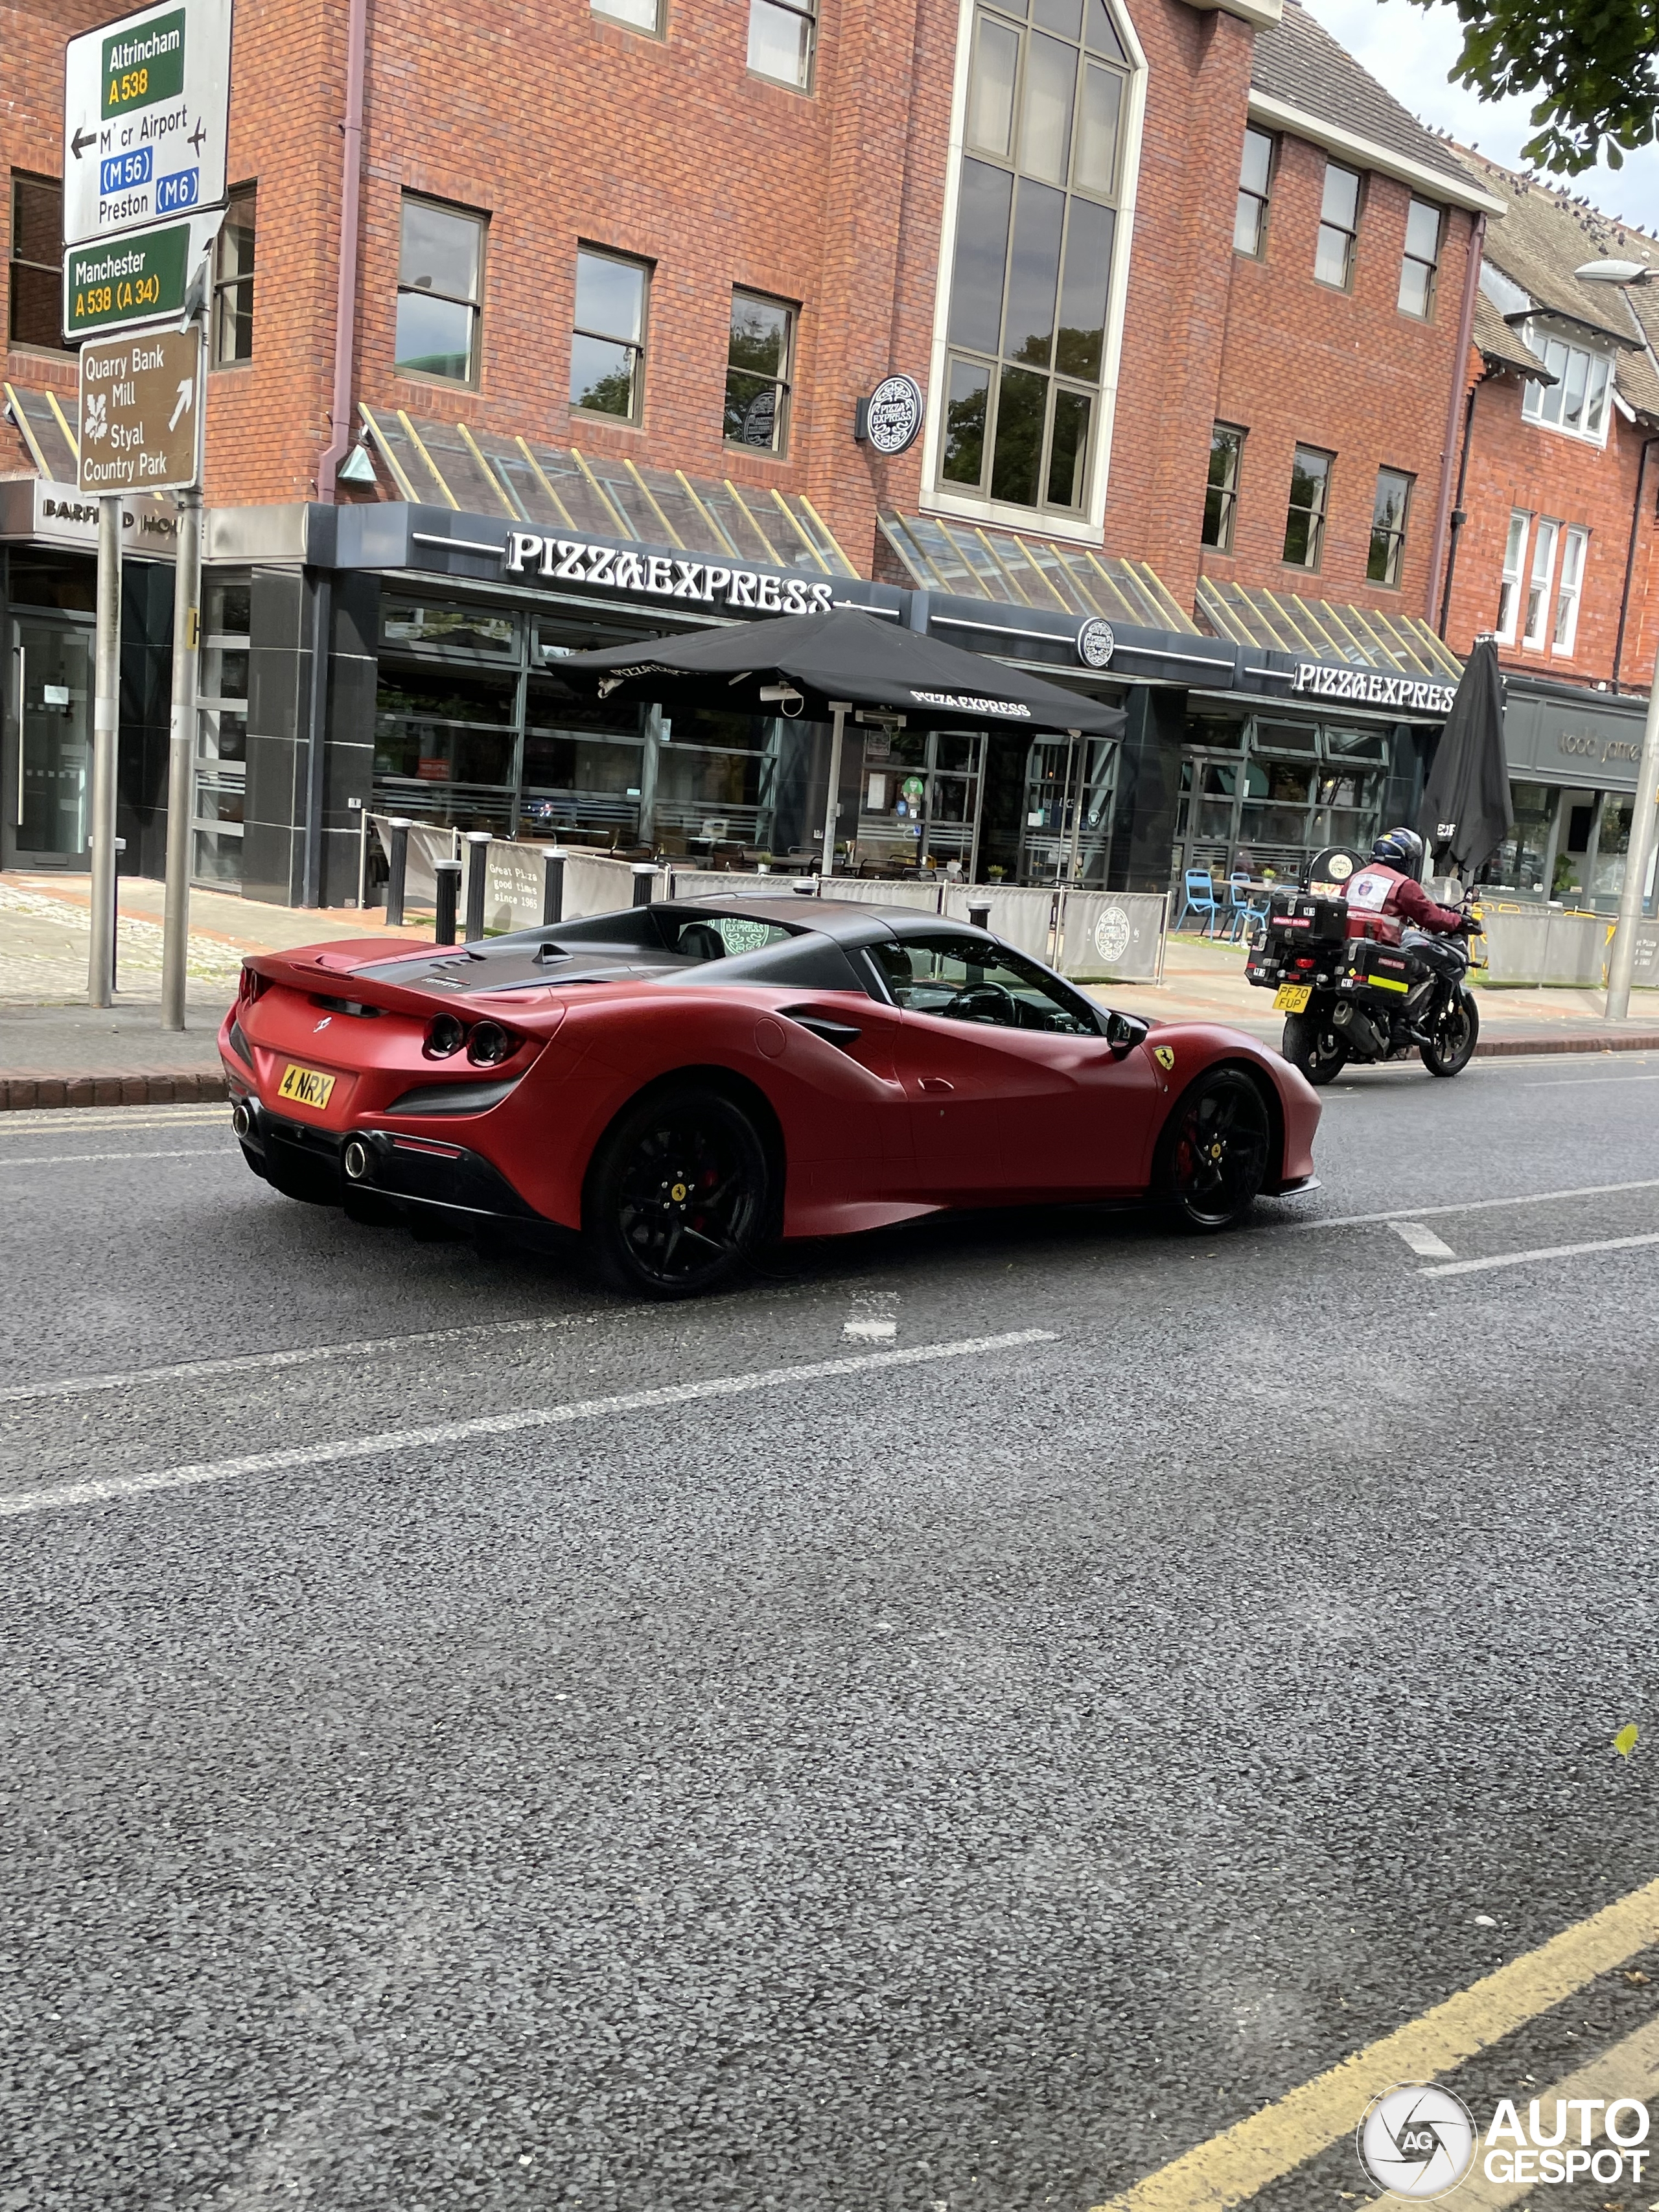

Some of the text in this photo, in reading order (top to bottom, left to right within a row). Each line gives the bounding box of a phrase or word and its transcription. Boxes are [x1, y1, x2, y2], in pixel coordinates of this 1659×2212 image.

[109, 29, 180, 73] Altrincham
[139, 104, 187, 141] Airport
[99, 171, 198, 224] Preston (M6)
[75, 251, 146, 286] Manchester
[86, 344, 164, 382] Quarry Bank
[112, 381, 135, 407] Mill
[880, 402, 905, 413] PIZZA
[872, 410, 912, 425] EXPRESS
[111, 421, 144, 451] Styal
[84, 451, 167, 482] Country Park
[506, 531, 833, 614] PIZZAEXPRESS
[1291, 662, 1457, 712] PIZZAEXPRES
[489, 863, 513, 876] Great
[494, 879, 513, 890] good
[494, 892, 537, 909] since 1965
[726, 924, 764, 933] EXPRESS
[1279, 986, 1309, 999] PF70
[1279, 998, 1301, 1008] FUP
[284, 1069, 331, 1106] 4 NRX
